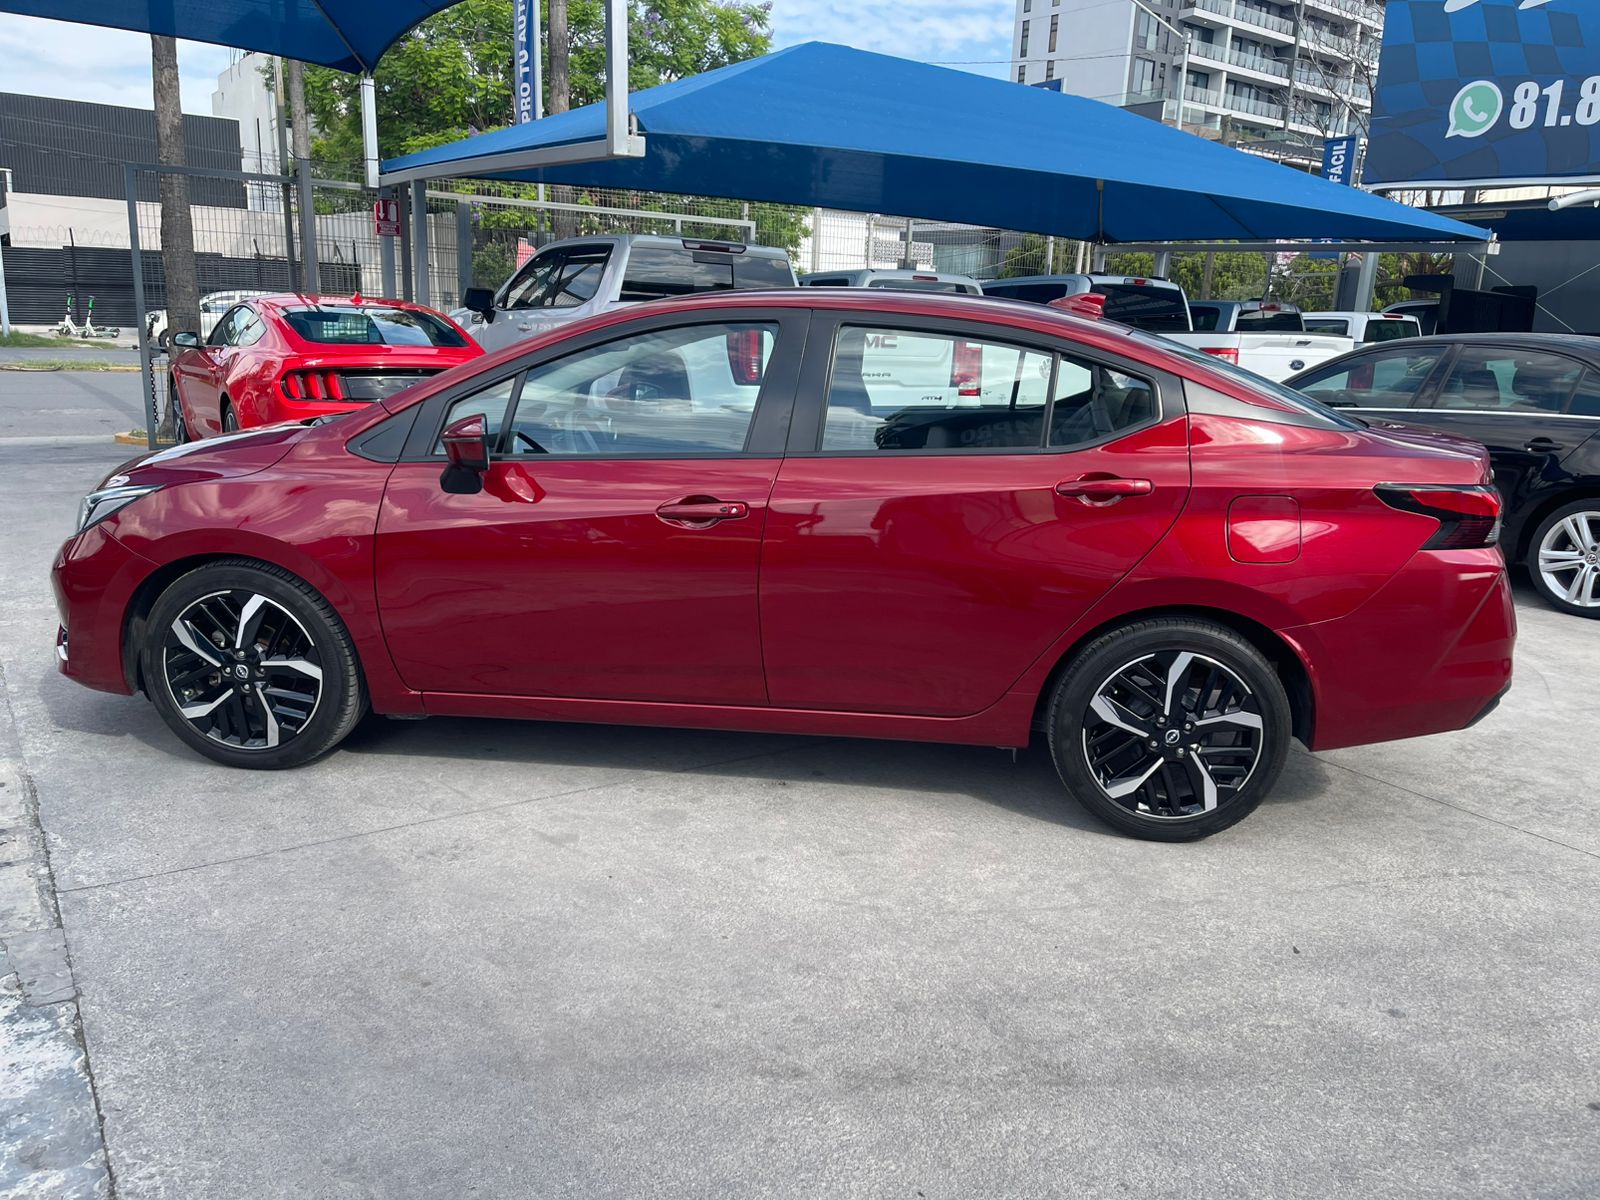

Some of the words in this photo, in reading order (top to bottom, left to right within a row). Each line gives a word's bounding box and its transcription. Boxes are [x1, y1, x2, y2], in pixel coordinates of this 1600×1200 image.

[517, 0, 527, 42] AUT
[519, 49, 530, 77] TU
[1508, 75, 1600, 130] 81.8
[1327, 140, 1347, 183] FÁCIL
